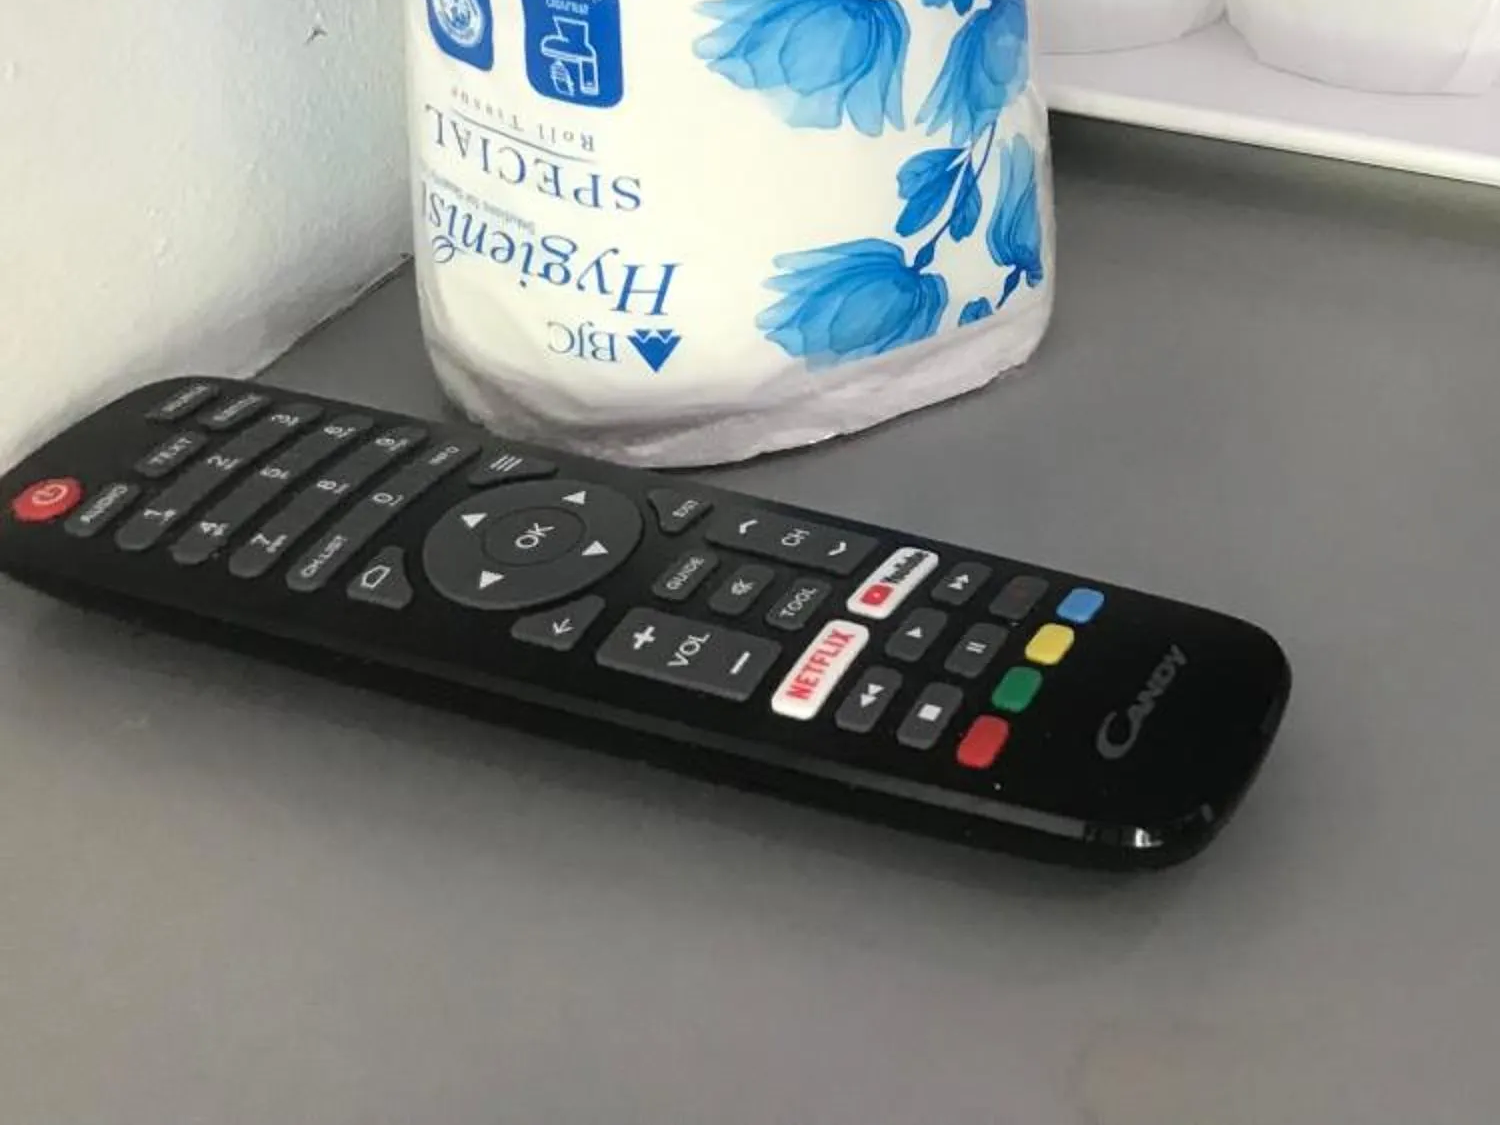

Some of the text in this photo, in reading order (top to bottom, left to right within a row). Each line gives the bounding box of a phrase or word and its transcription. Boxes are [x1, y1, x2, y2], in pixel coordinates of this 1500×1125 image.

[537, 122, 595, 153] Roll
[423, 103, 642, 212] SPECIAL
[546, 321, 618, 365] BJC
[515, 522, 556, 549] OK
[781, 528, 811, 547] CH
[667, 632, 712, 667] VOL
[785, 627, 858, 701] NETFLIX
